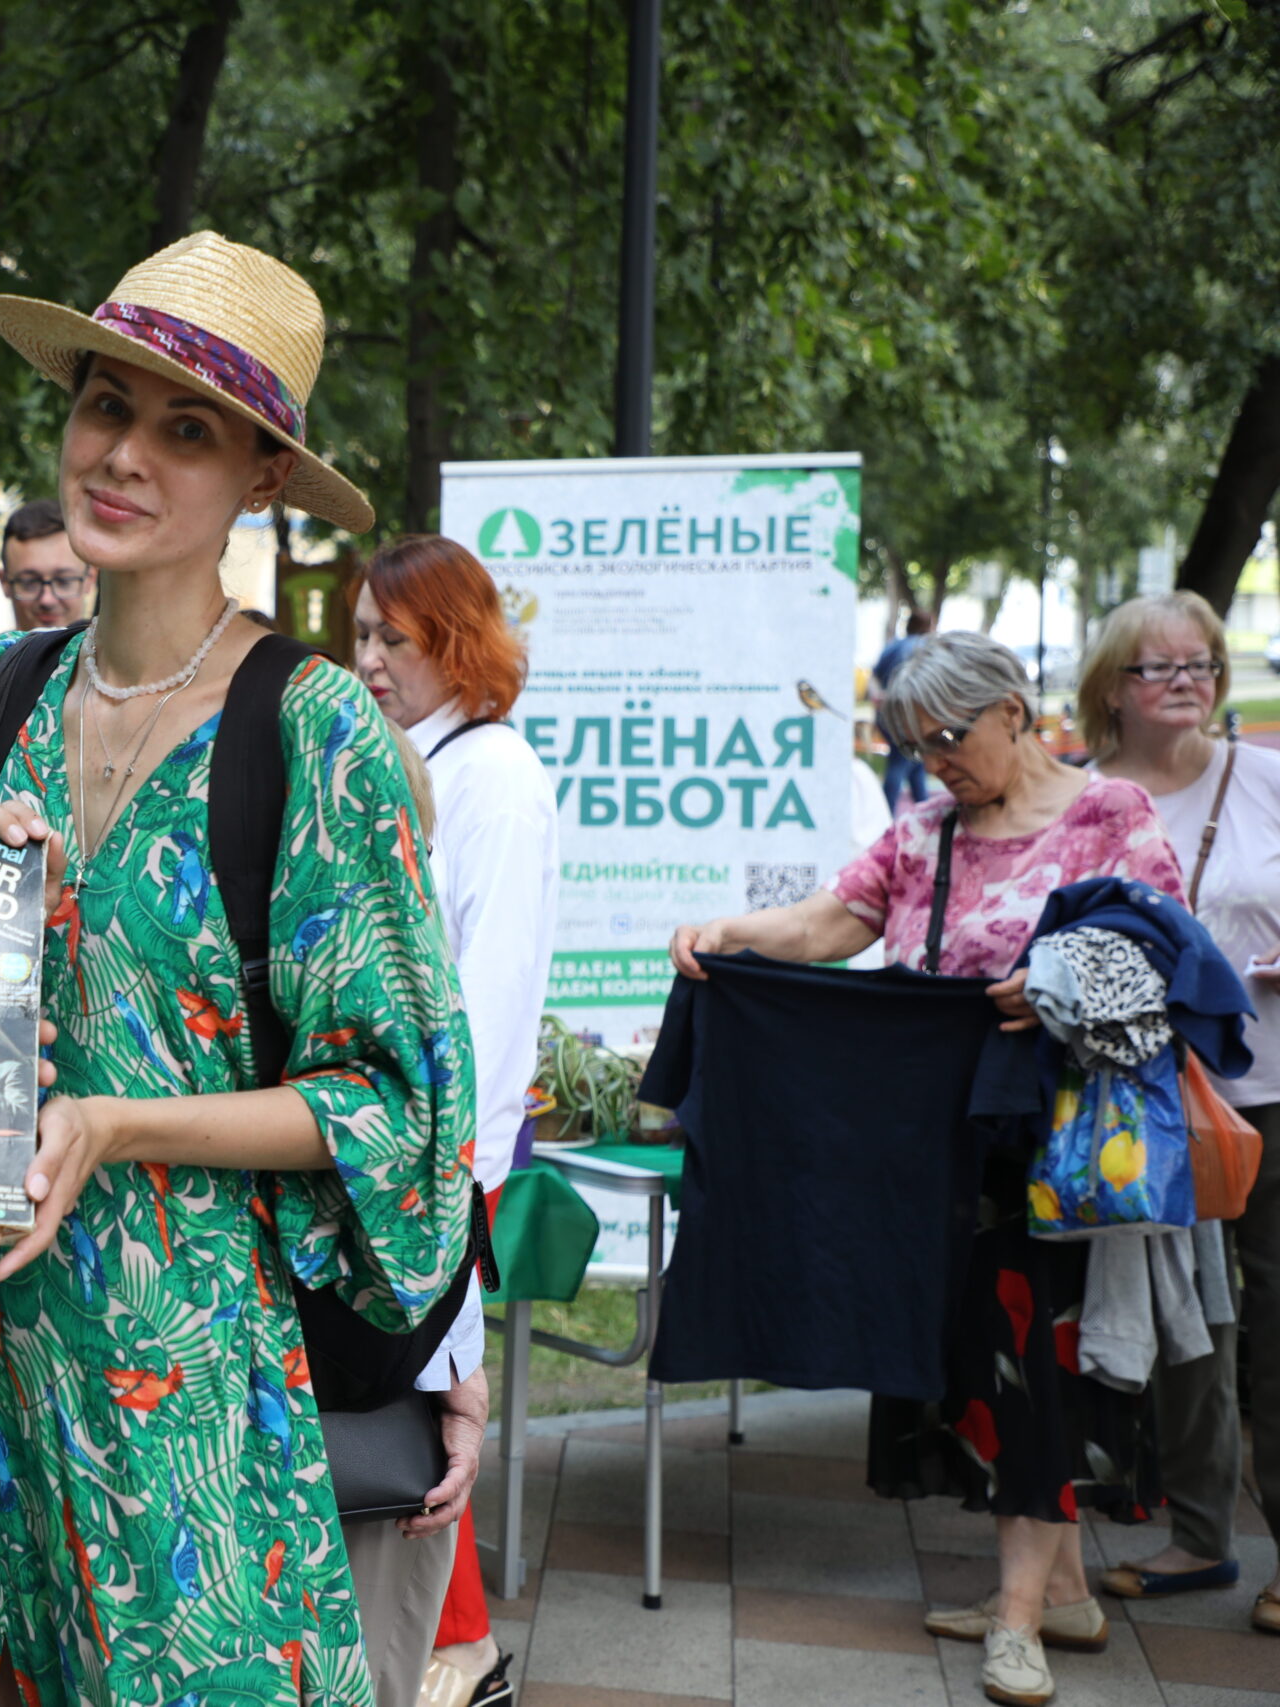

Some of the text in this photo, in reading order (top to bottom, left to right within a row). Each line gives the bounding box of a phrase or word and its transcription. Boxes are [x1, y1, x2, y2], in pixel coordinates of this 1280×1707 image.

[549, 505, 812, 558] ЗЕЛЁНЫЕ
[510, 699, 815, 768] ЕЛЁНАЯ
[560, 859, 730, 885] ЕДИНЯЙТЕСЬ!
[552, 957, 678, 979] ЕВАЕМ ЖИЗ
[601, 977, 676, 998] КОЛИЧ
